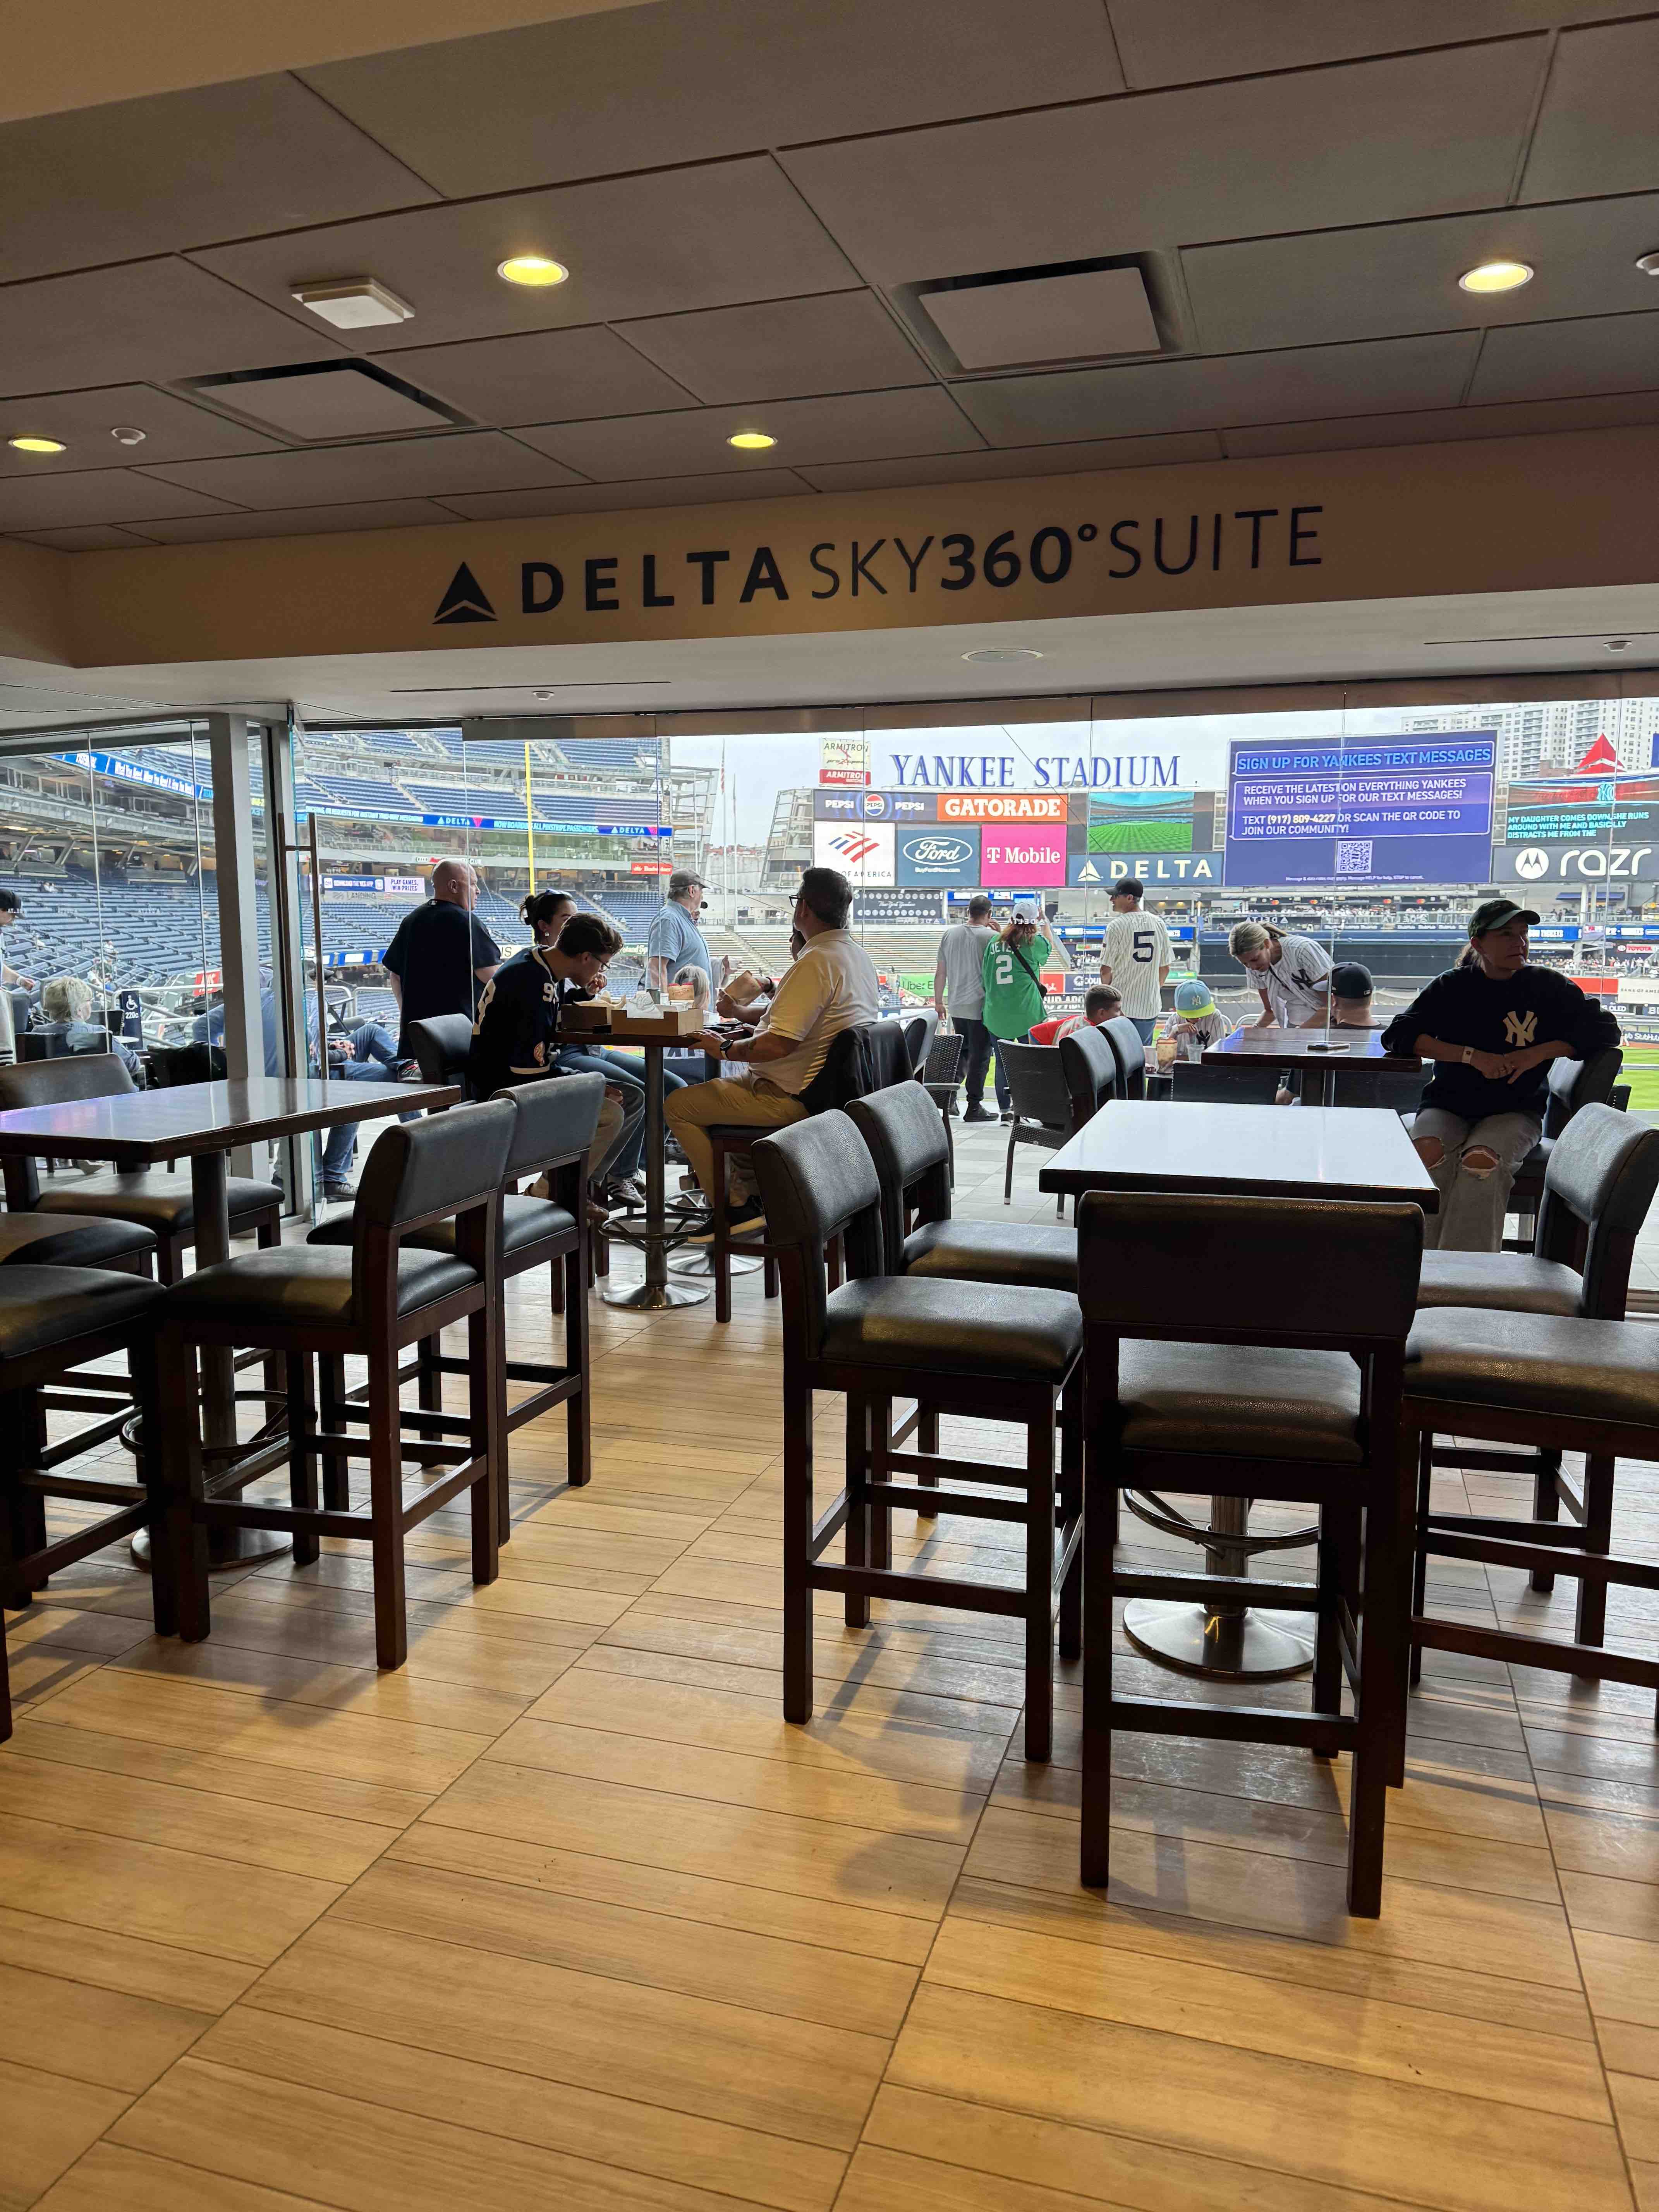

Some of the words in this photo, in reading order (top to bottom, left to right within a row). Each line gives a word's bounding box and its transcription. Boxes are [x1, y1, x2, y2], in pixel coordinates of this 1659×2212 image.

[522, 547, 789, 614] DELTA
[1238, 758, 1268, 770] SIGN
[1272, 757, 1290, 769] UP
[1294, 756, 1319, 768] FOR
[1322, 754, 1381, 767] YANKEES
[1384, 752, 1418, 765] TEXT
[1419, 748, 1491, 763] MESSAGES
[889, 754, 1015, 787] YANKEE
[1034, 756, 1180, 787] STADIUM
[1244, 785, 1283, 795] RECEIVE
[1285, 784, 1304, 793] THE
[1305, 783, 1340, 793] LATEST
[1341, 783, 1356, 792] ON
[1358, 780, 1419, 791] EVERYTHING
[1422, 779, 1467, 788] YANKEES
[825, 800, 854, 809] PEPSI
[895, 802, 924, 811] PEPSI
[1243, 796, 1272, 805] WHEN
[1274, 795, 1293, 804] YOU
[1296, 795, 1319, 804] SIGN
[1321, 794, 1335, 803] UP
[1339, 794, 1356, 802] FOR
[1358, 793, 1379, 802] OUR
[1381, 792, 1406, 801] TEXT
[1407, 790, 1462, 800] MESSAGES!
[945, 799, 1061, 817] GATORADE
[1242, 816, 1266, 824] TEXT
[1267, 814, 1291, 825] (917)
[1293, 814, 1336, 824] 809-4227
[1338, 813, 1351, 823] OR
[1353, 813, 1379, 822] SCAN
[1381, 812, 1401, 822] THE
[1403, 811, 1417, 821] QR
[1419, 811, 1446, 821] CODE
[1447, 810, 1461, 820] TO
[1521, 815, 1559, 823] DAUGHTER
[1242, 826, 1264, 835] JOIN
[1266, 826, 1286, 835] OUR
[1288, 824, 1349, 835] COMMUNITY!
[915, 840, 961, 860] Ford
[1004, 847, 1061, 864] Mobile
[1110, 859, 1212, 879] DELTA
[1560, 848, 1652, 877] razr
[991, 940, 1019, 955] JETE
[1132, 931, 1155, 963] 5
[996, 955, 1013, 985] 2
[543, 982, 556, 1004] 9
[902, 981, 926, 990] Uber
[1503, 1010, 1538, 1046] NY
